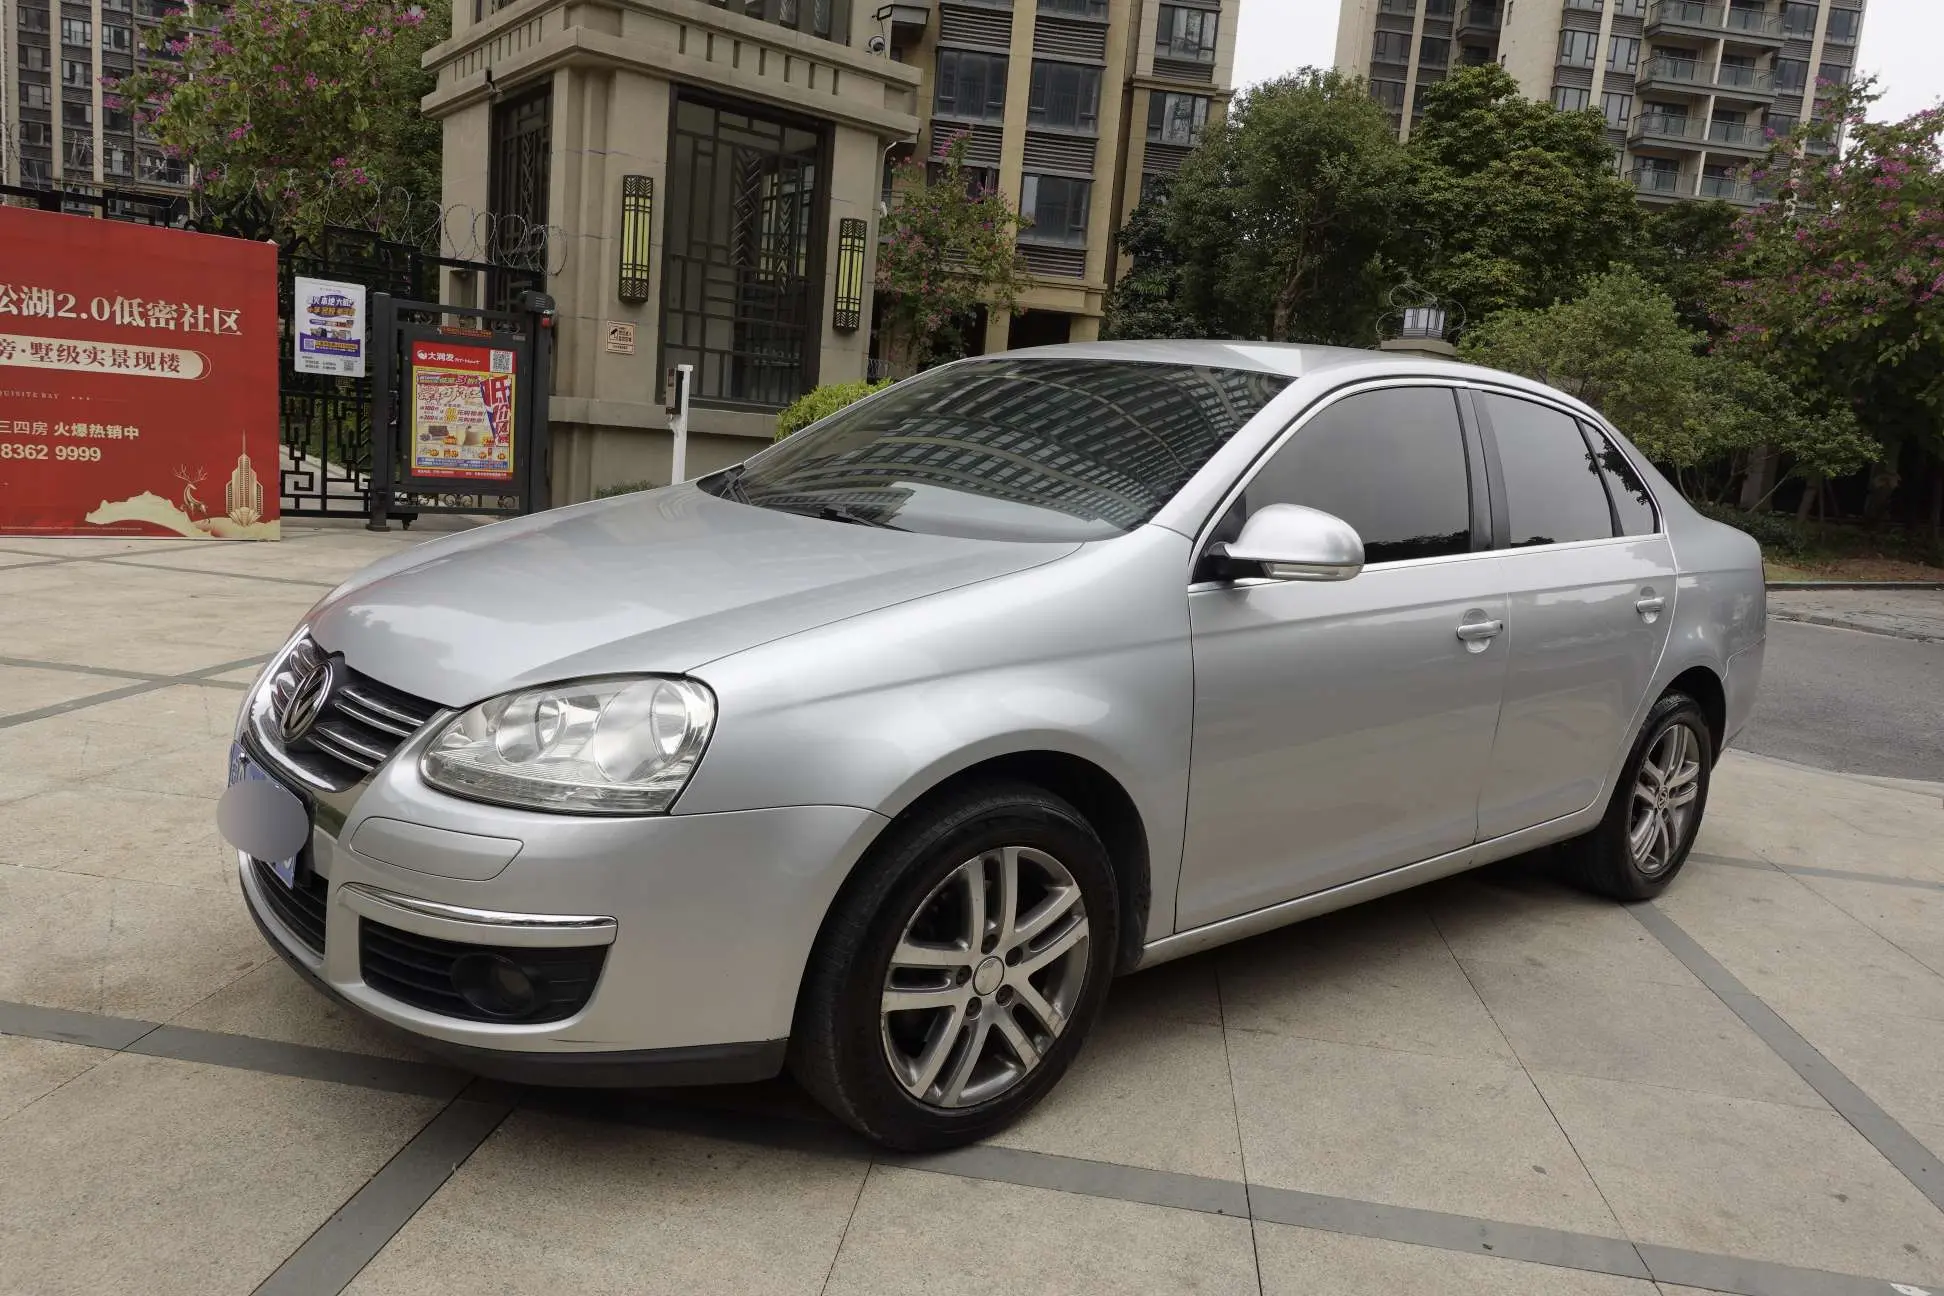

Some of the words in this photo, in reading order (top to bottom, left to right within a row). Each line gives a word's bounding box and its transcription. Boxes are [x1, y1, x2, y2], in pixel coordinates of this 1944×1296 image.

[0, 420, 49, 436] 三四房
[54, 421, 140, 440] 火爆热销中
[0, 443, 49, 460] 8362
[55, 445, 102, 462] 9999
